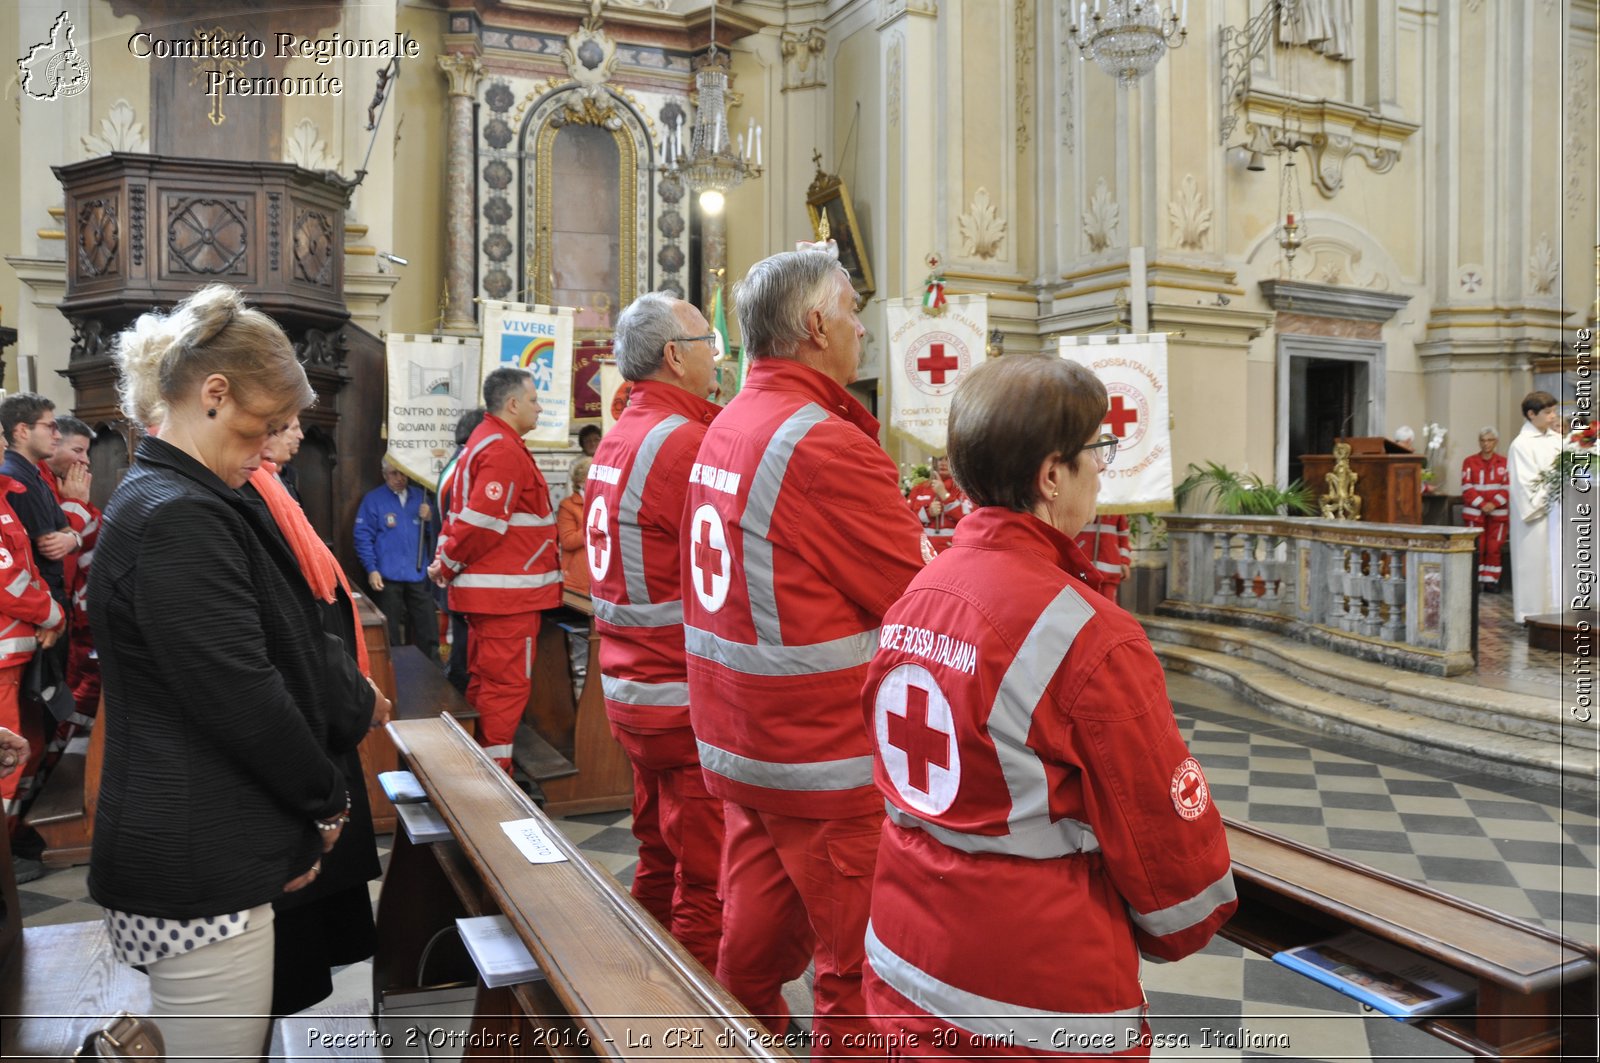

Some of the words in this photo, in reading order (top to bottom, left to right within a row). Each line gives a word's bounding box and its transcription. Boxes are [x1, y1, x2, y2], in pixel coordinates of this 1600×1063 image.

[502, 319, 556, 336] VIVERE
[1092, 357, 1128, 370] ROSSA
[393, 406, 434, 417] CENTRO
[397, 423, 436, 432] GIOVANI
[389, 439, 438, 449] PECETTO
[1118, 444, 1165, 479] TORINESE
[900, 626, 935, 658] ROSSA
[931, 634, 977, 676] ITALIANA
